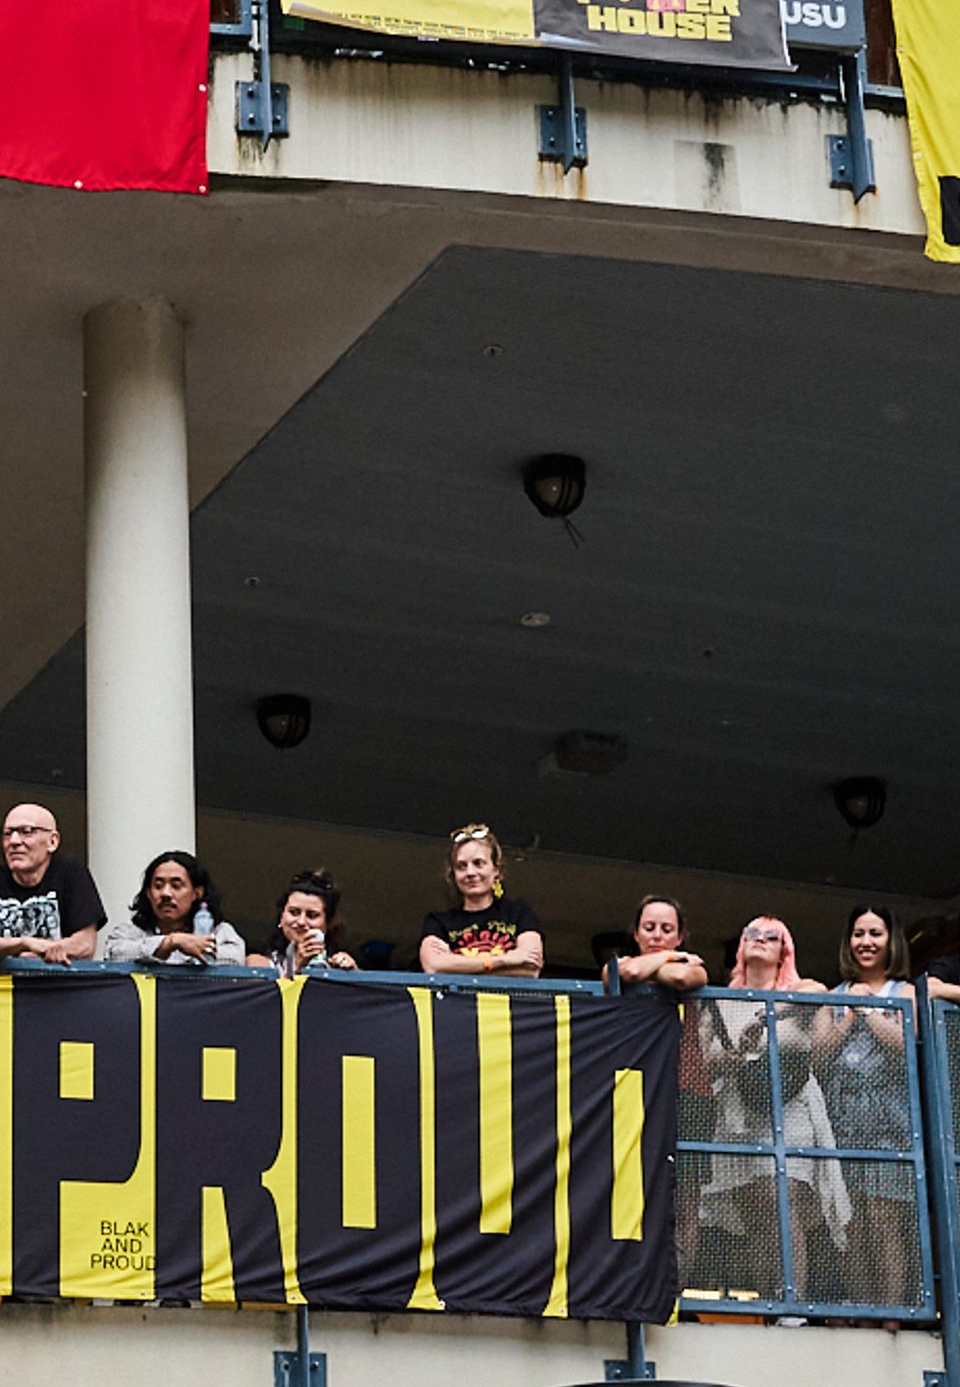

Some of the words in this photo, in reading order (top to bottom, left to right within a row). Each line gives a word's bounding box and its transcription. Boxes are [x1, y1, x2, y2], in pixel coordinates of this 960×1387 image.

[587, 4, 733, 42] HOUSE
[782, 0, 847, 29] USU
[12, 971, 680, 1325] PROUD
[100, 1220, 149, 1237] BLAK
[100, 1238, 142, 1253] AND
[90, 1253, 156, 1271] PROUD
